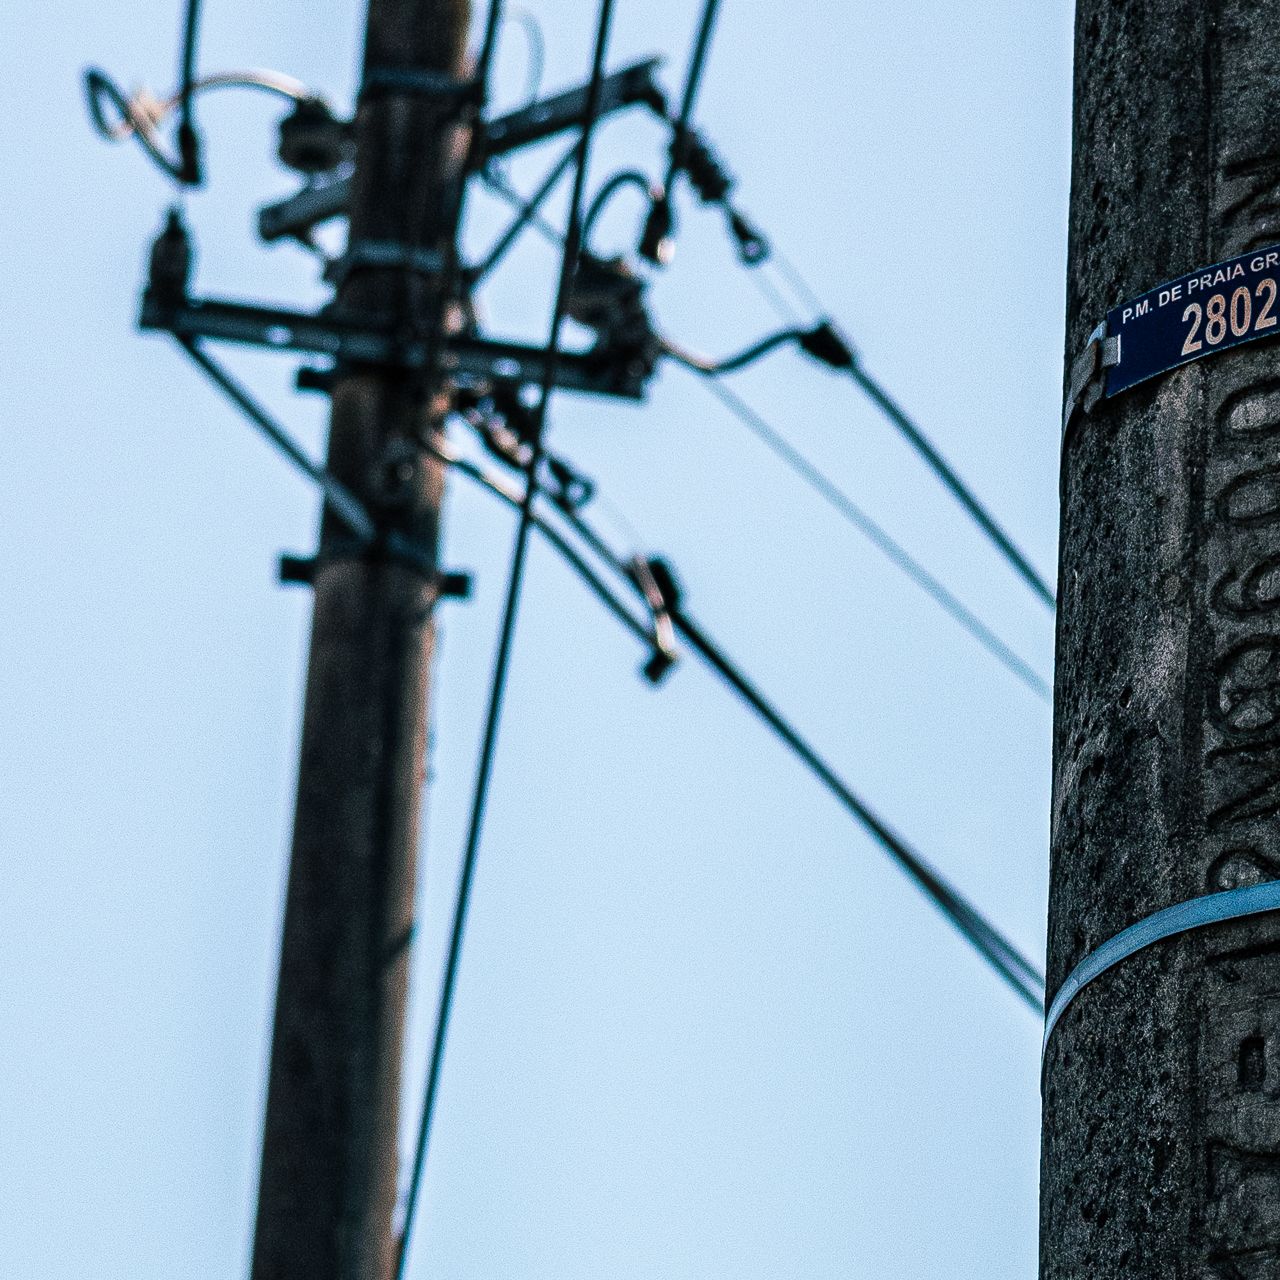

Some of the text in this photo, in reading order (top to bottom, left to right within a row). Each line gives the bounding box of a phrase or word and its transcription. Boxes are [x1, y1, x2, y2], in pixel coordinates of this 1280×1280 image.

[1121, 301, 1153, 324] P.M.
[1158, 286, 1182, 307] DE
[1187, 263, 1245, 295] PRAIA
